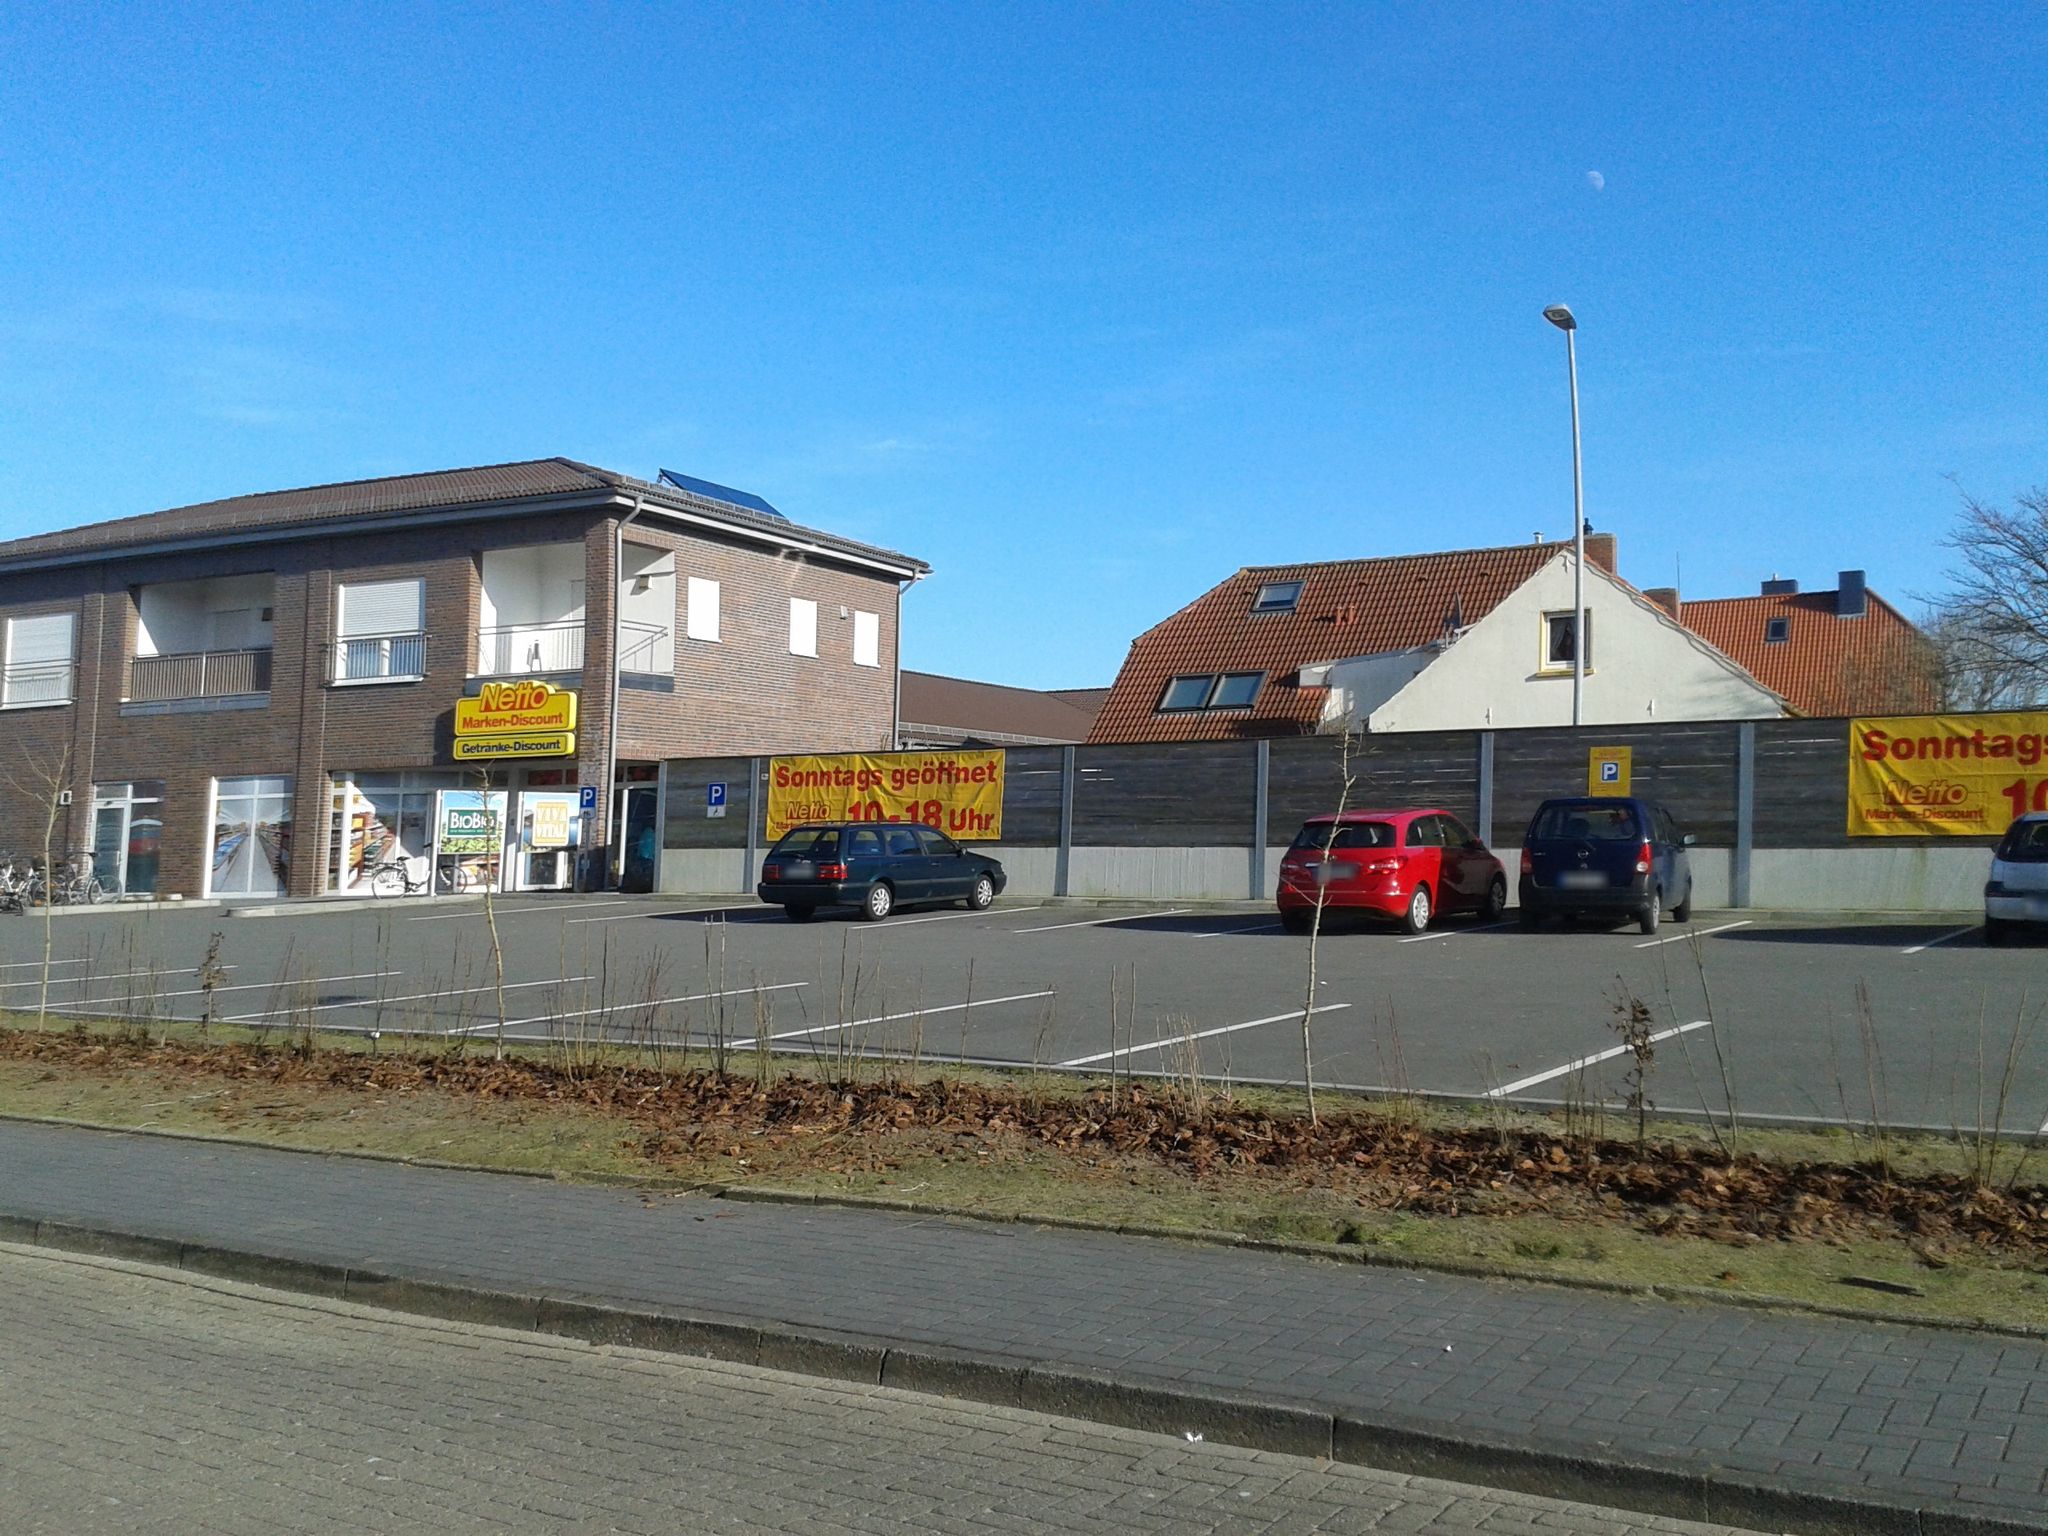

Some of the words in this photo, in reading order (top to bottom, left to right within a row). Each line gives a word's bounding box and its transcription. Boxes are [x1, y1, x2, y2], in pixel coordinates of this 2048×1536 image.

[480, 682, 549, 712] Netto
[462, 713, 563, 729] Marken-Discount
[462, 740, 561, 754] Getränke-Discount
[776, 765, 883, 792] Sonntags
[891, 760, 997, 791] geöffnet
[1603, 764, 1617, 780] P
[582, 789, 593, 806] P
[711, 785, 722, 804] P
[1884, 780, 1968, 805] Netto
[786, 801, 831, 820] Netto
[949, 808, 995, 831] Uhr
